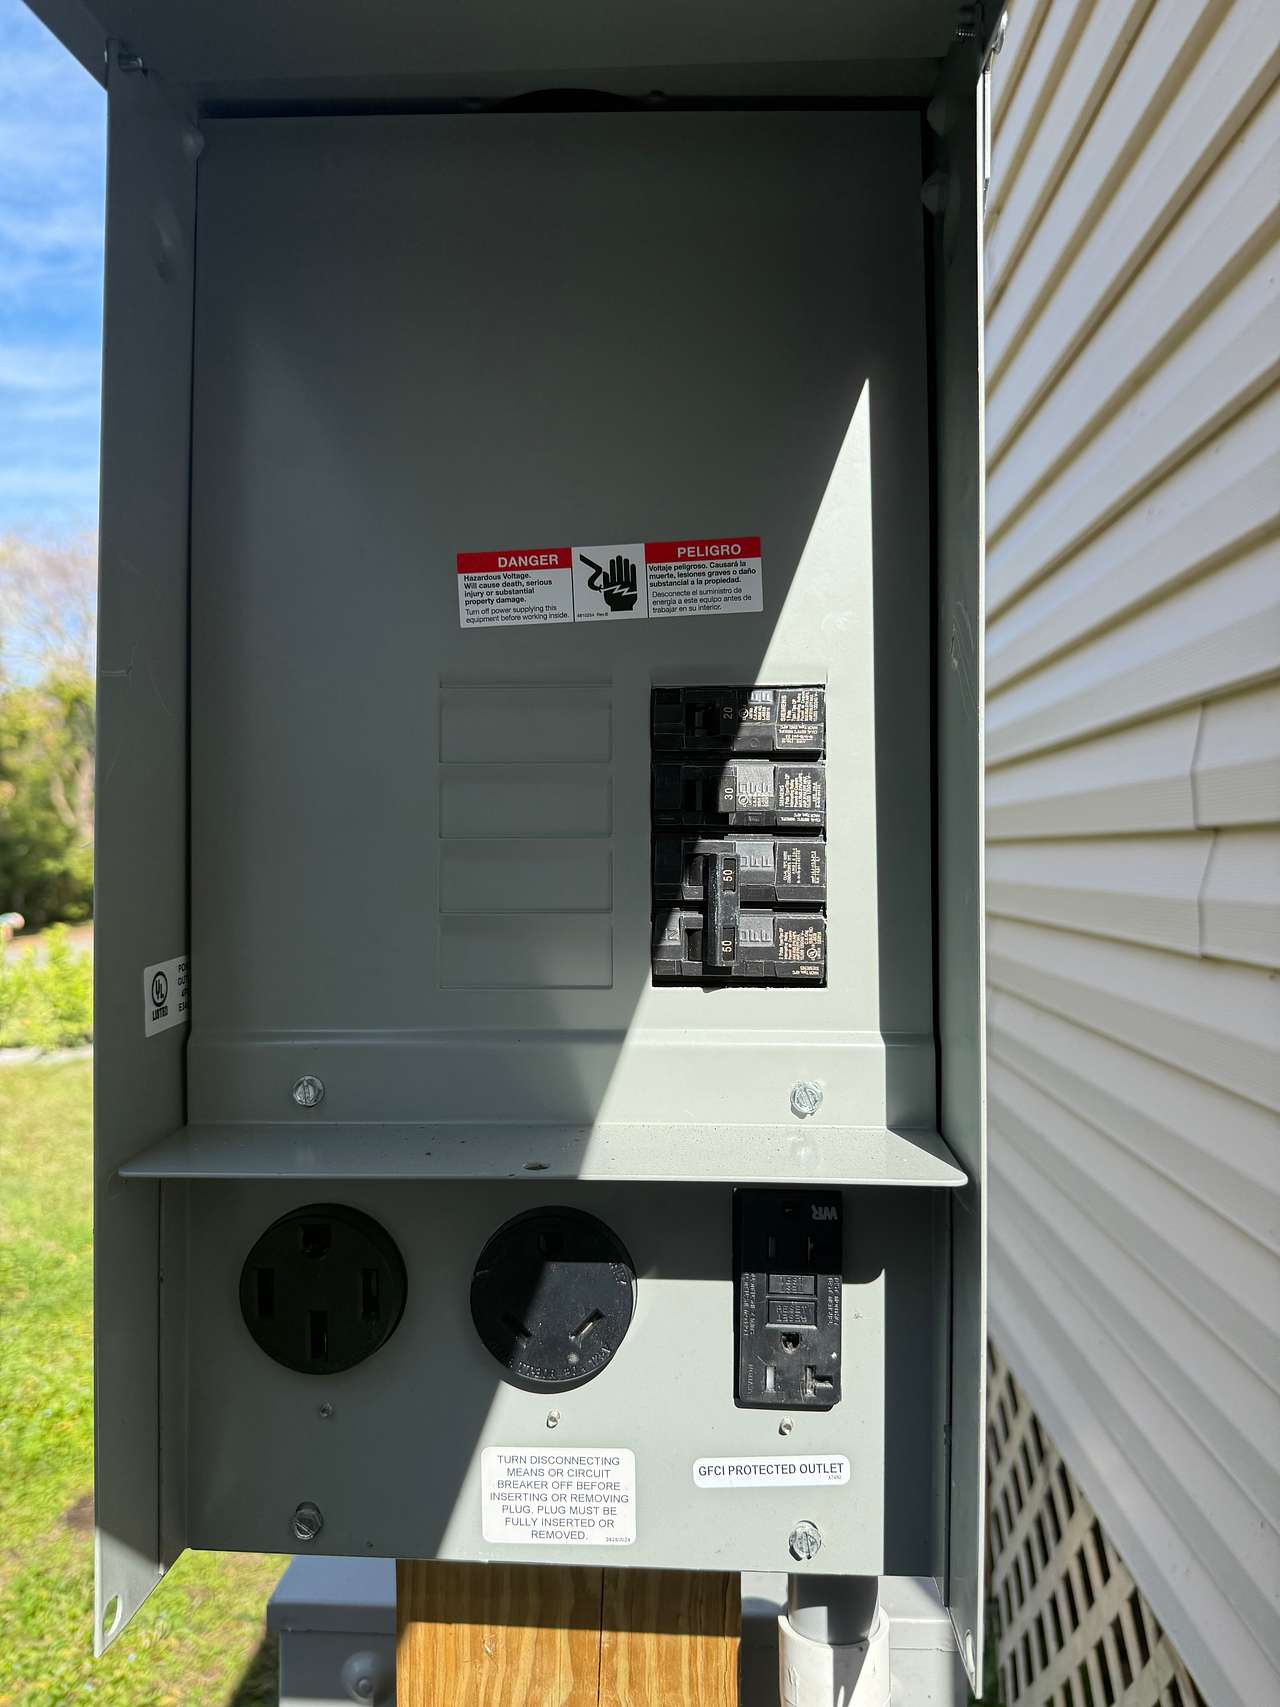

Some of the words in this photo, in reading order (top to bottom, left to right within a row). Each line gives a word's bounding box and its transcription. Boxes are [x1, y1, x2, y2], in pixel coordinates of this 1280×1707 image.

[677, 544, 742, 558] PELIGRO
[498, 554, 559, 568] DANGER
[649, 564, 672, 572] Voltaje
[674, 563, 707, 571] peligroso.
[503, 572, 531, 580] Voltage.
[502, 580, 524, 588] death,
[649, 579, 689, 587] substancial
[704, 577, 741, 586] propiedad.
[465, 590, 483, 598] injury
[495, 588, 535, 596] substantial
[652, 589, 690, 598] Desconecte
[699, 587, 732, 595] suministro
[465, 598, 495, 607] property
[496, 597, 526, 605] damage.
[699, 596, 722, 605] equipo
[513, 605, 544, 613] supplying
[653, 606, 678, 614] trabajar
[466, 615, 499, 624] equipment
[523, 612, 548, 620] working
[723, 706, 733, 720] 20
[725, 787, 733, 801] 30
[723, 869, 733, 882] 50
[722, 939, 732, 954] 50
[152, 1006, 168, 1021] LISTED
[811, 1204, 838, 1221] WR
[497, 1455, 527, 1464] TURN
[530, 1456, 620, 1465] DISCONNECTING
[506, 1468, 545, 1477] MEANS
[548, 1468, 564, 1477] OR
[567, 1469, 611, 1478] CIRCUIT
[698, 1465, 725, 1476] GFCI
[728, 1464, 796, 1475] PROTECTED
[799, 1463, 844, 1474] OUTLET
[497, 1480, 548, 1489] BREAKER
[551, 1481, 573, 1490] OFF
[577, 1482, 621, 1490] BEFORE
[490, 1493, 548, 1502] INSERTING
[551, 1493, 567, 1502] OR
[570, 1494, 629, 1503] REMOVING
[537, 1505, 566, 1514] PLUG
[570, 1506, 600, 1515] MUST
[603, 1507, 617, 1515] BE
[505, 1517, 538, 1526] FULLY
[542, 1518, 595, 1527] INSERTED
[598, 1519, 614, 1528] OR
[531, 1530, 588, 1540] REMOVED.
